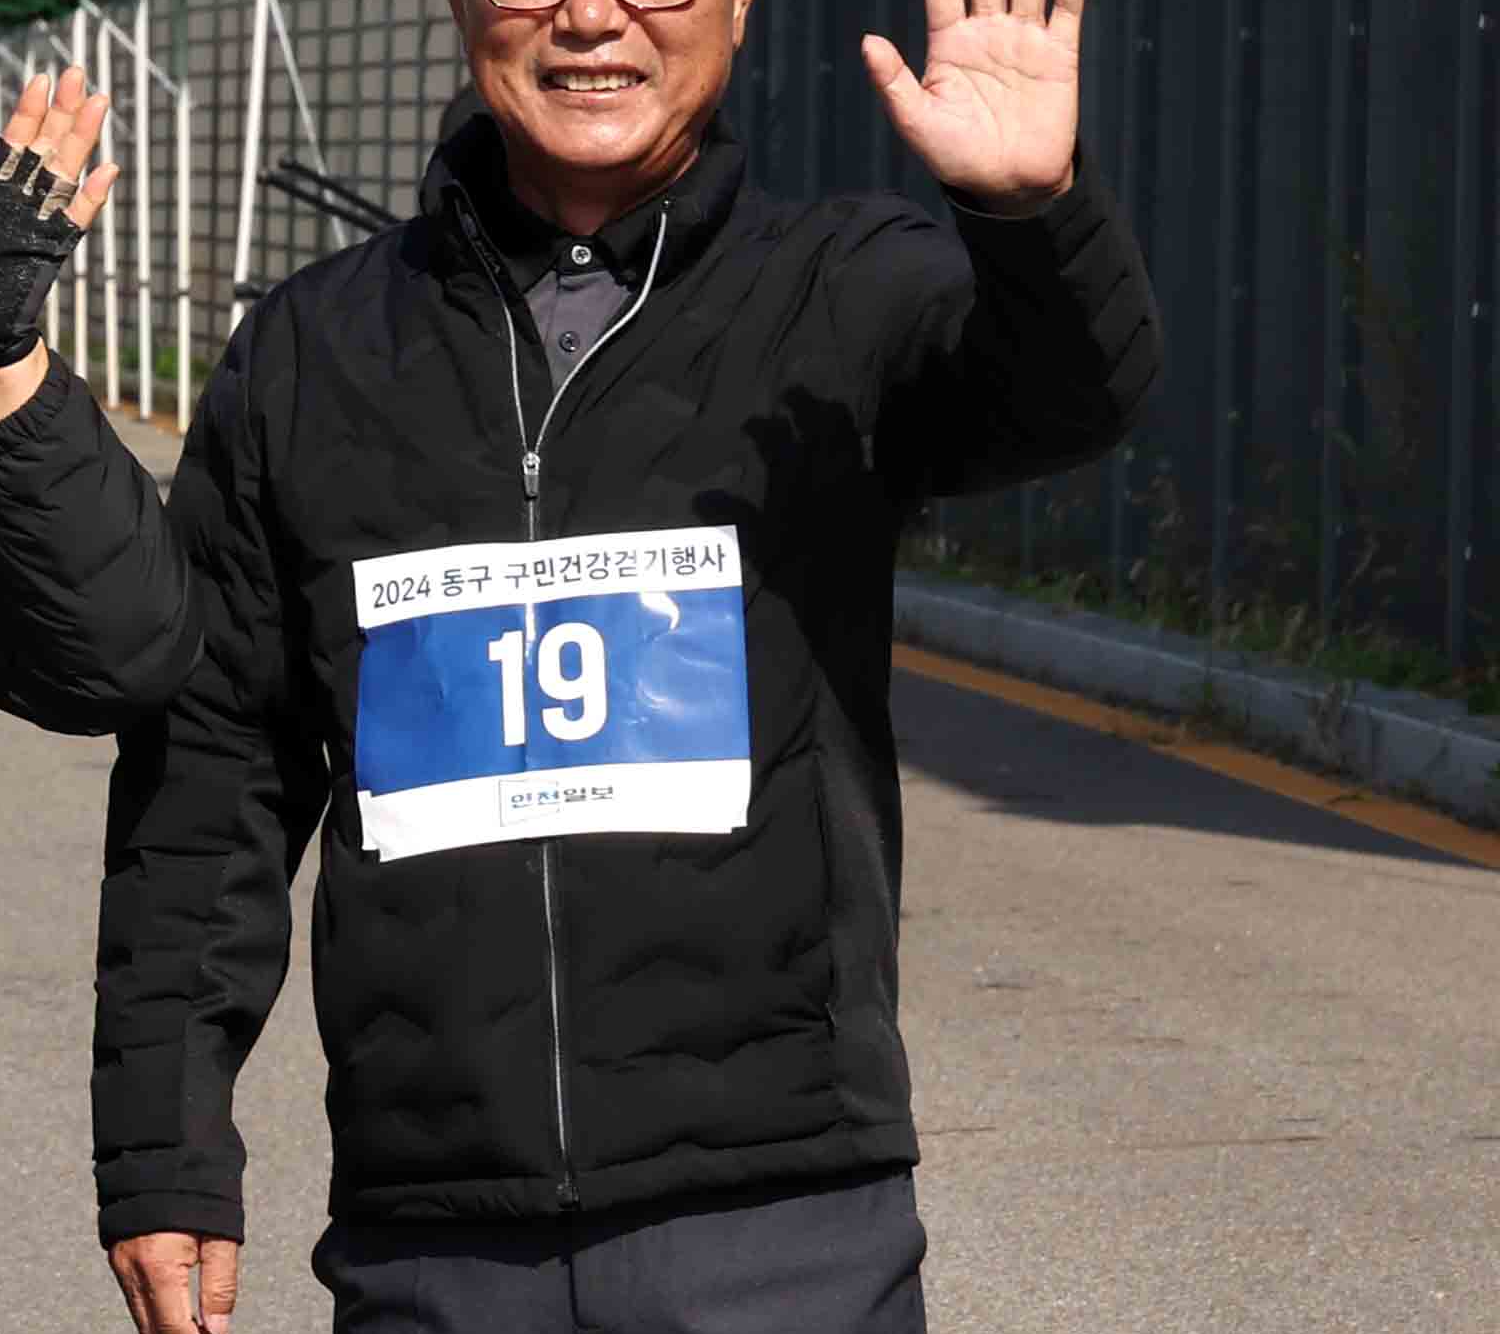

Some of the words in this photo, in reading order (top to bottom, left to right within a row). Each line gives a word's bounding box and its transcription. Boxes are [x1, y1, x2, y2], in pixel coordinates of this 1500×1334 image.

[372, 574, 431, 608] 2024
[440, 565, 493, 597] 동구
[504, 543, 727, 590] 구민건강걷기행사
[488, 621, 609, 747] 19
[510, 786, 613, 809] 인천일보
